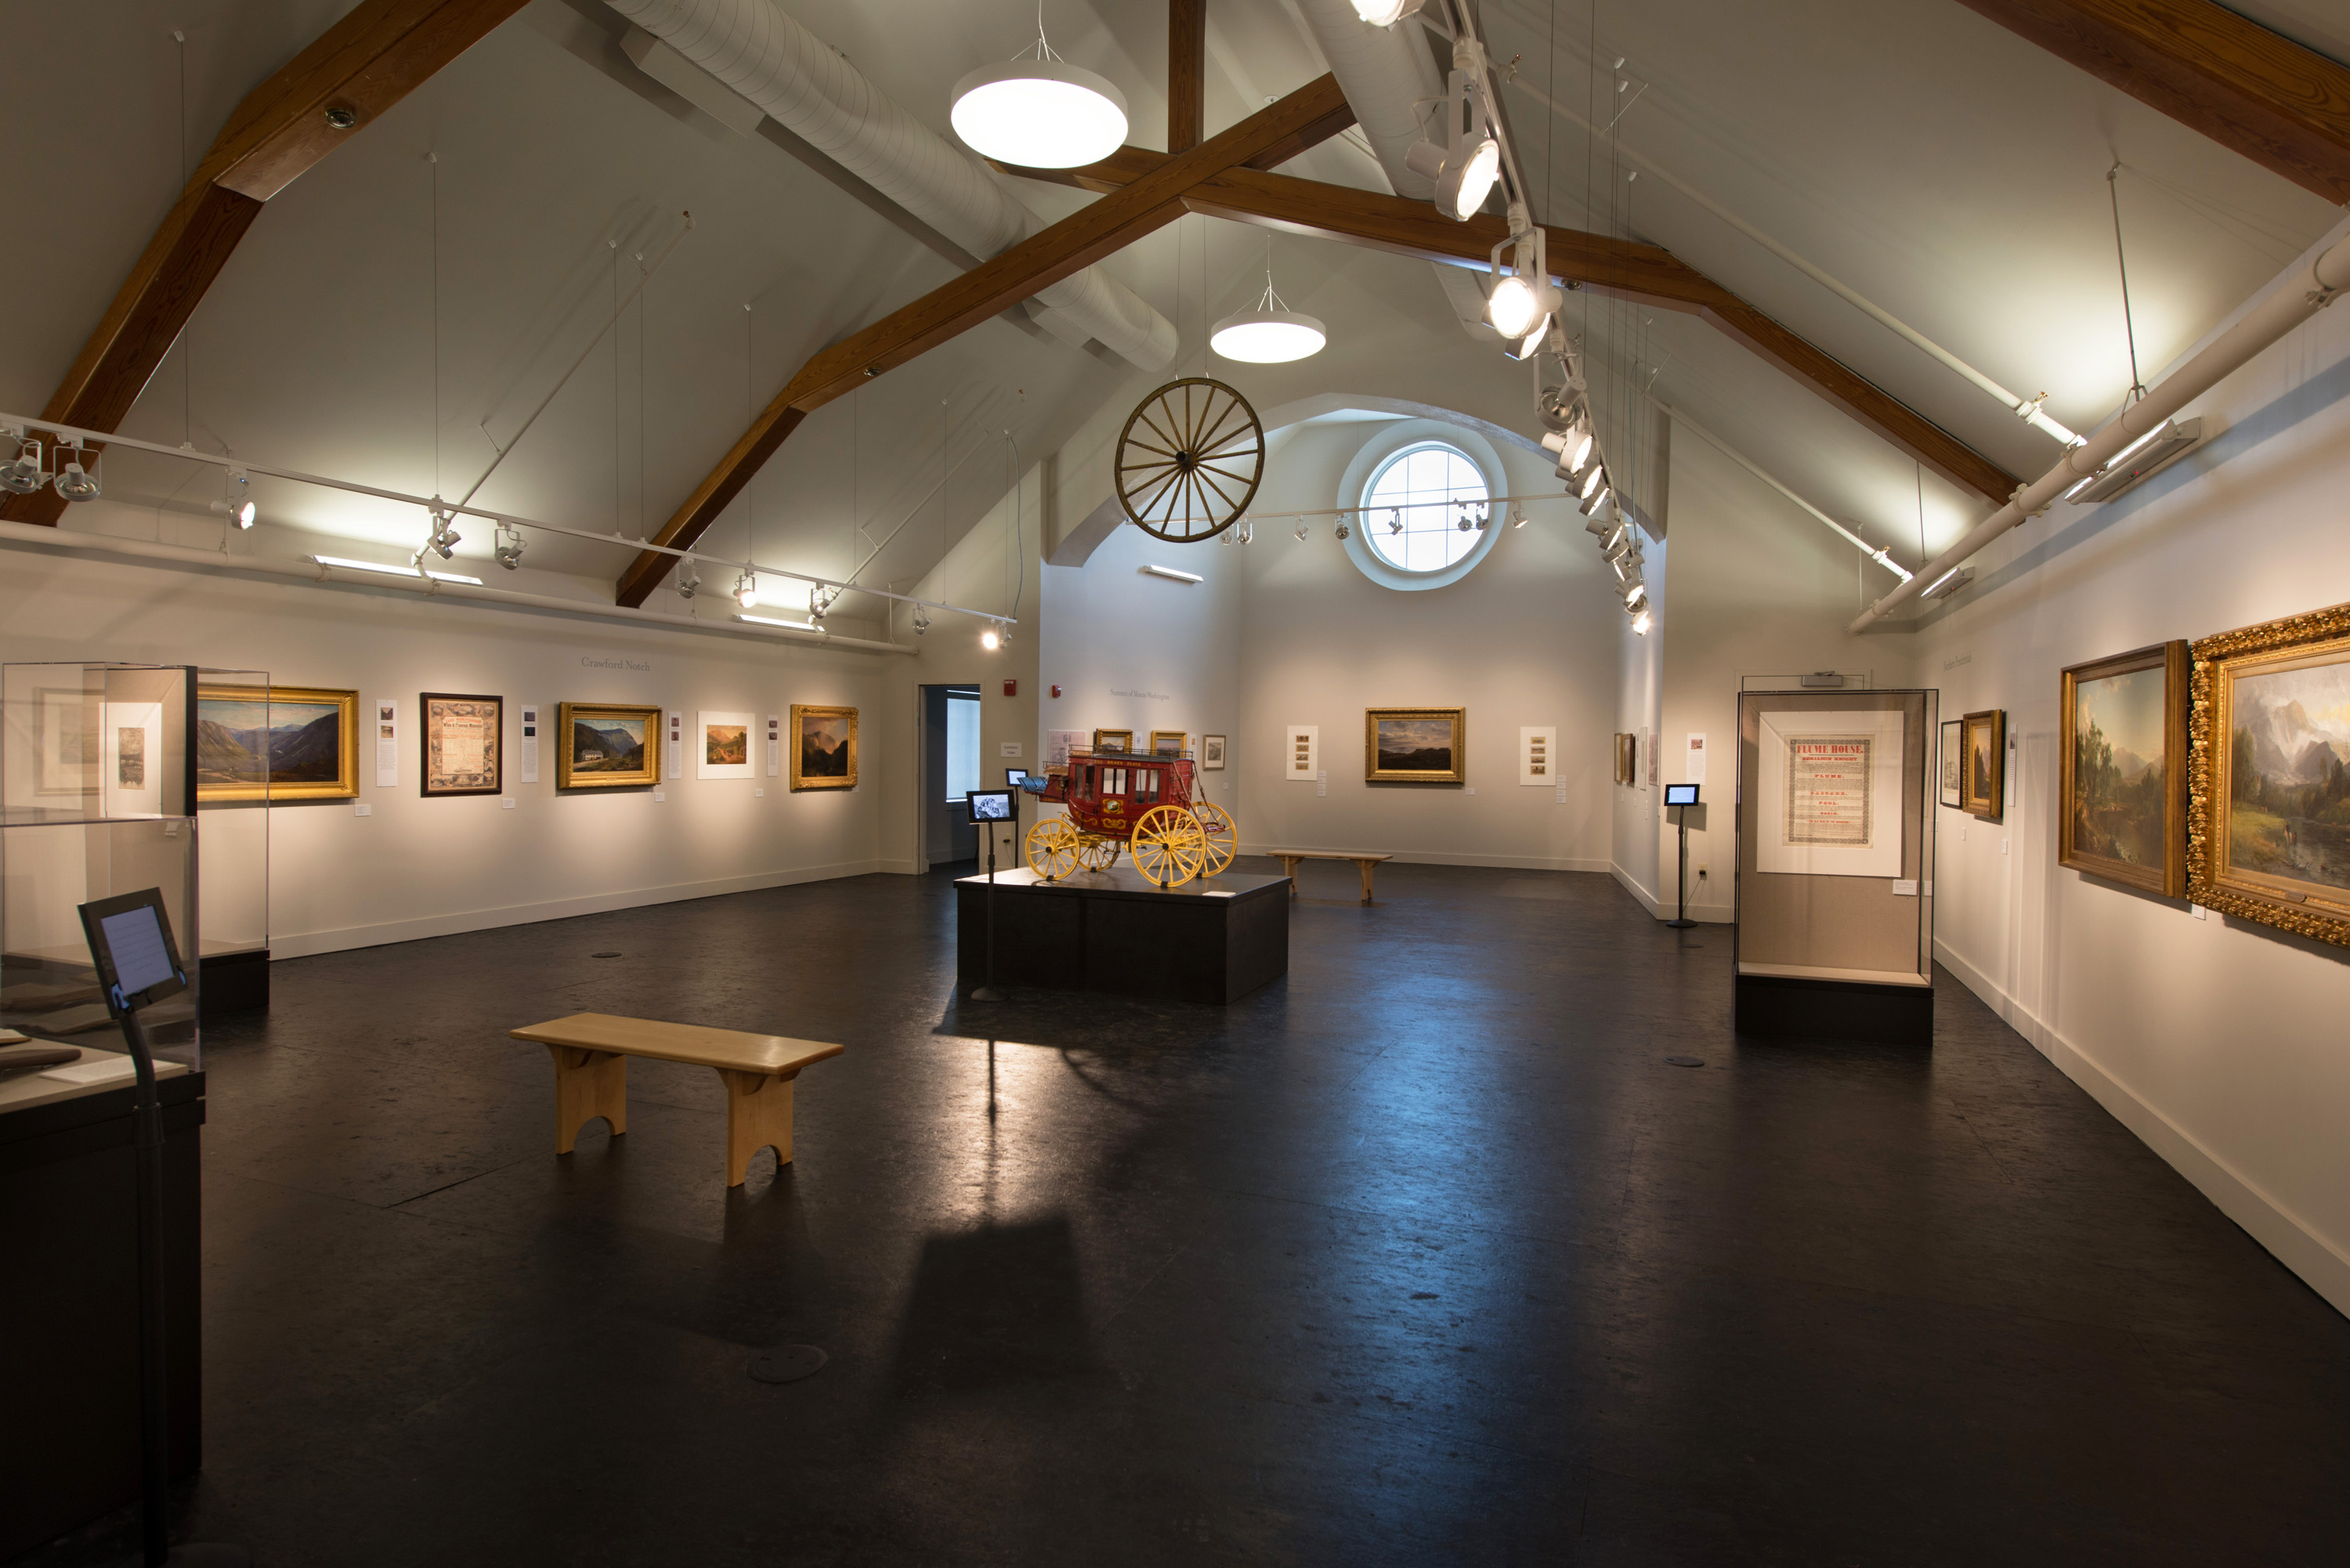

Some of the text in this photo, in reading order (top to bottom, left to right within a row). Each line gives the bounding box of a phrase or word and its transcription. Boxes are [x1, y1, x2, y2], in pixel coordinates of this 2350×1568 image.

[581, 656, 650, 671] Crawford Notch
[1797, 745, 1864, 753] FLUME HOUSE.
